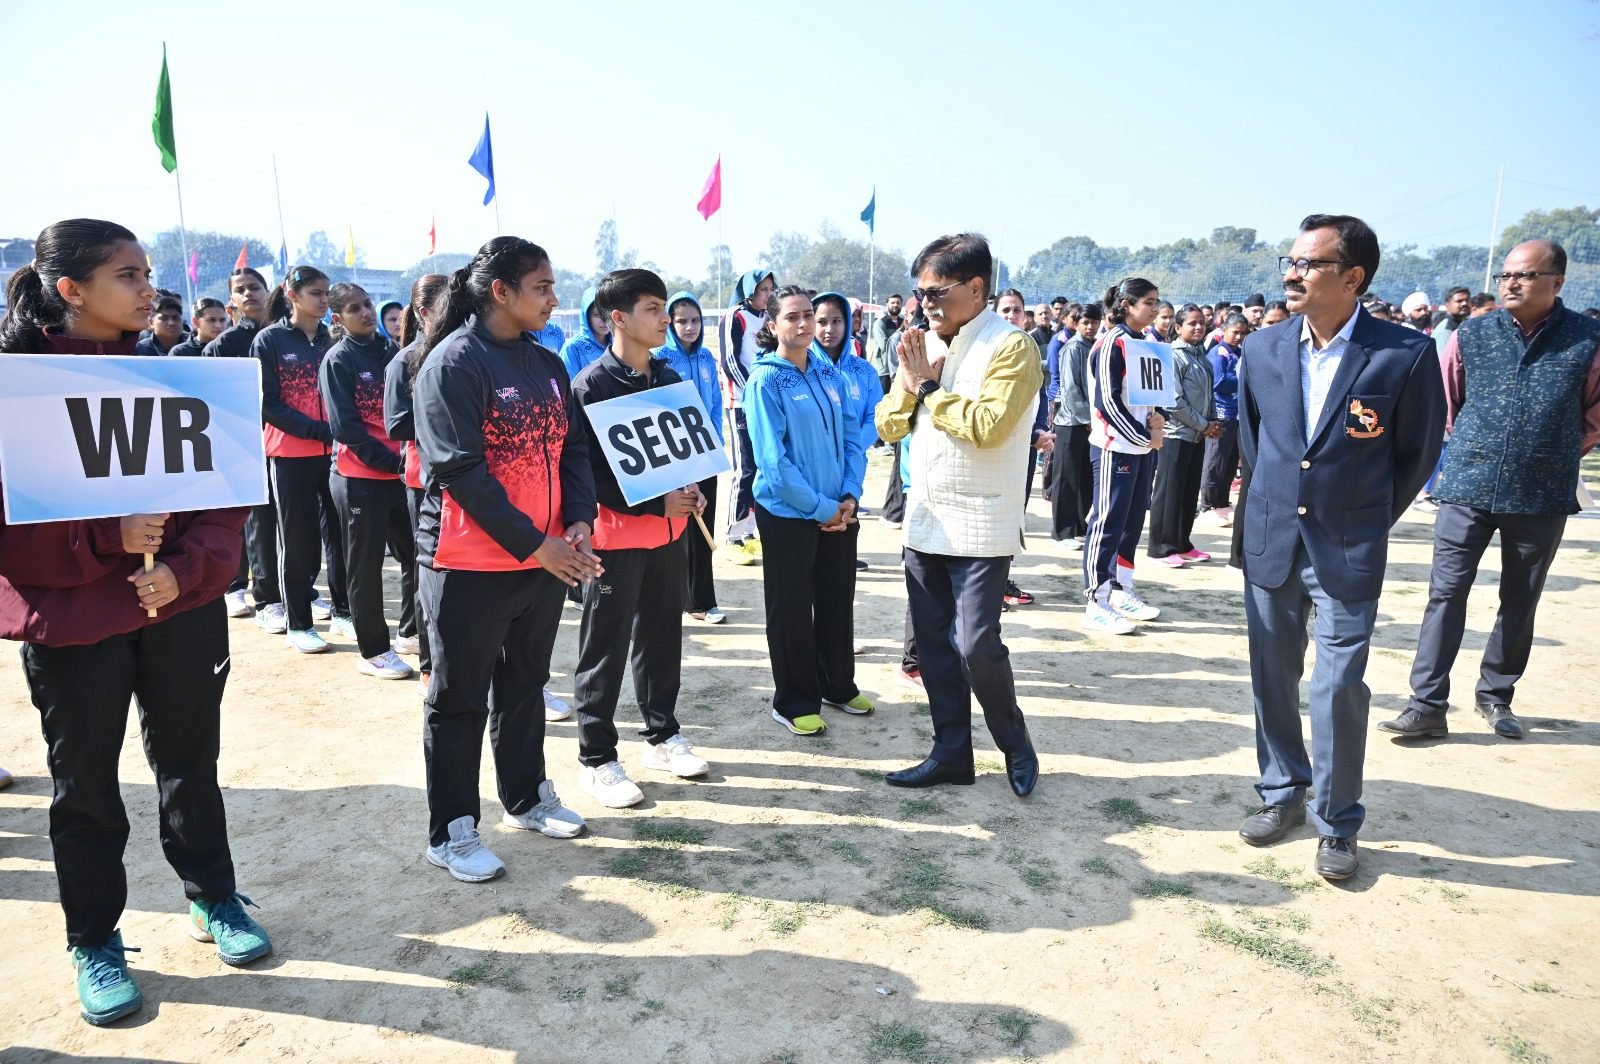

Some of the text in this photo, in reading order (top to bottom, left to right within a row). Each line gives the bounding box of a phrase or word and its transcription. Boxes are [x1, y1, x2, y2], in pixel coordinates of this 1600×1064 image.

[1140, 357, 1164, 391] NR
[65, 397, 214, 479] WR
[608, 407, 717, 476] SECR
